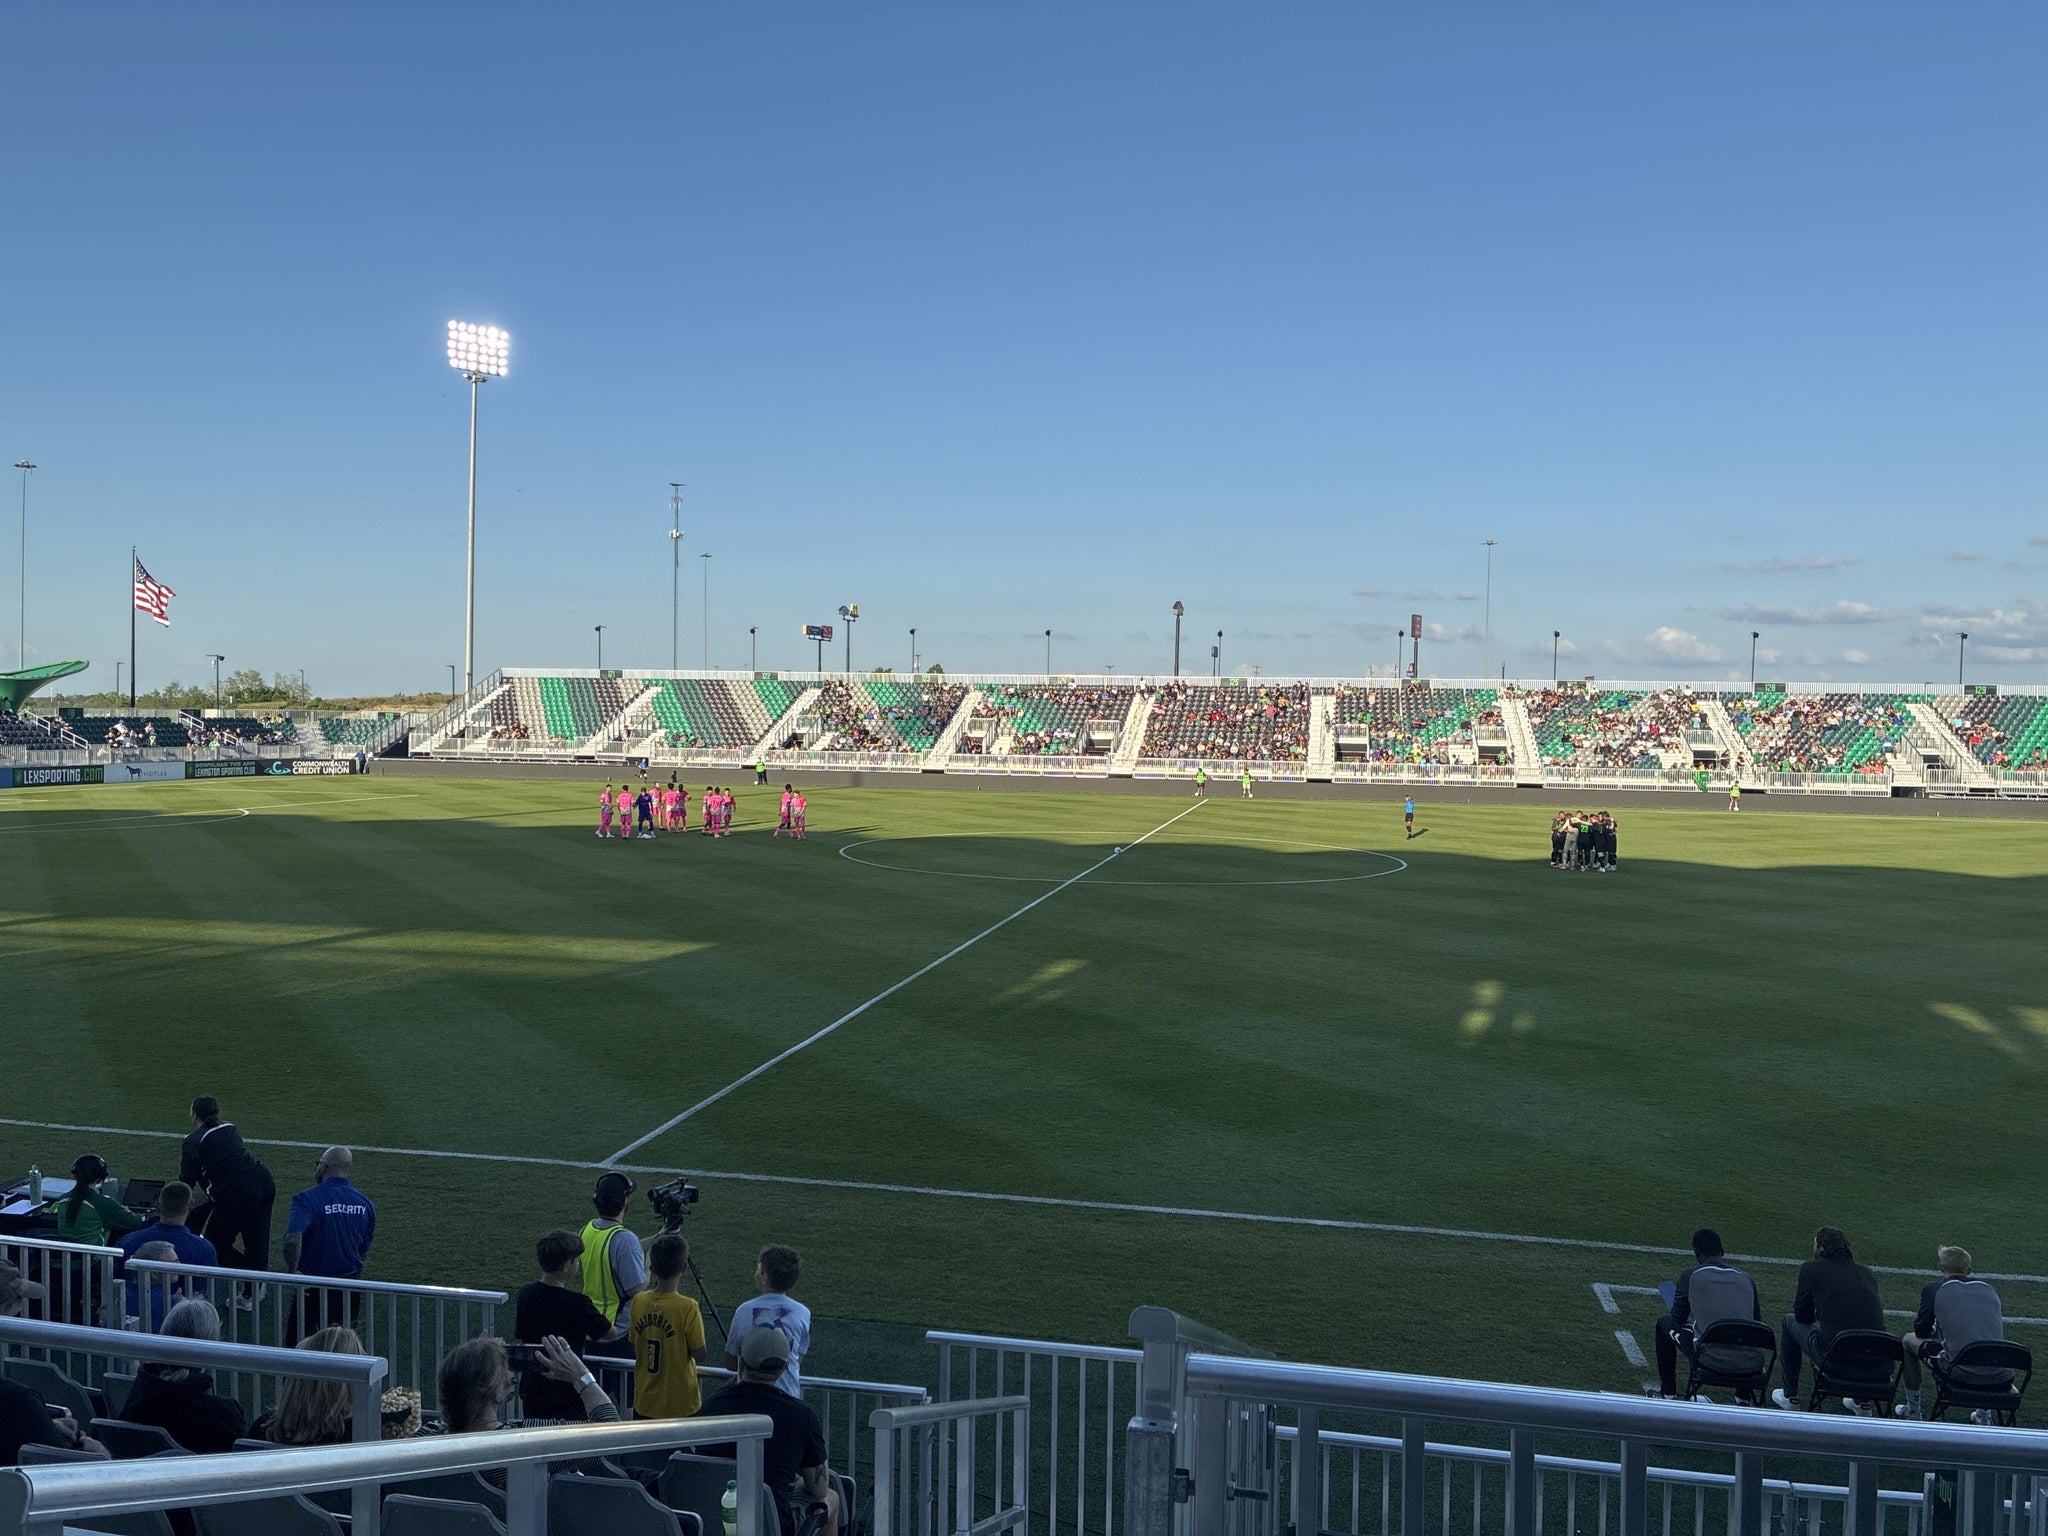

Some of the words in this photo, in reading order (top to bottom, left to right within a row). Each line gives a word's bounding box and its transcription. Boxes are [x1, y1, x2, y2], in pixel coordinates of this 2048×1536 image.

[1765, 684, 1776, 692] 128
[1975, 686, 1986, 695] 129
[292, 767, 321, 775] CREDIT
[322, 767, 350, 775] UNION
[23, 768, 103, 785] LEXSPORTING.COM
